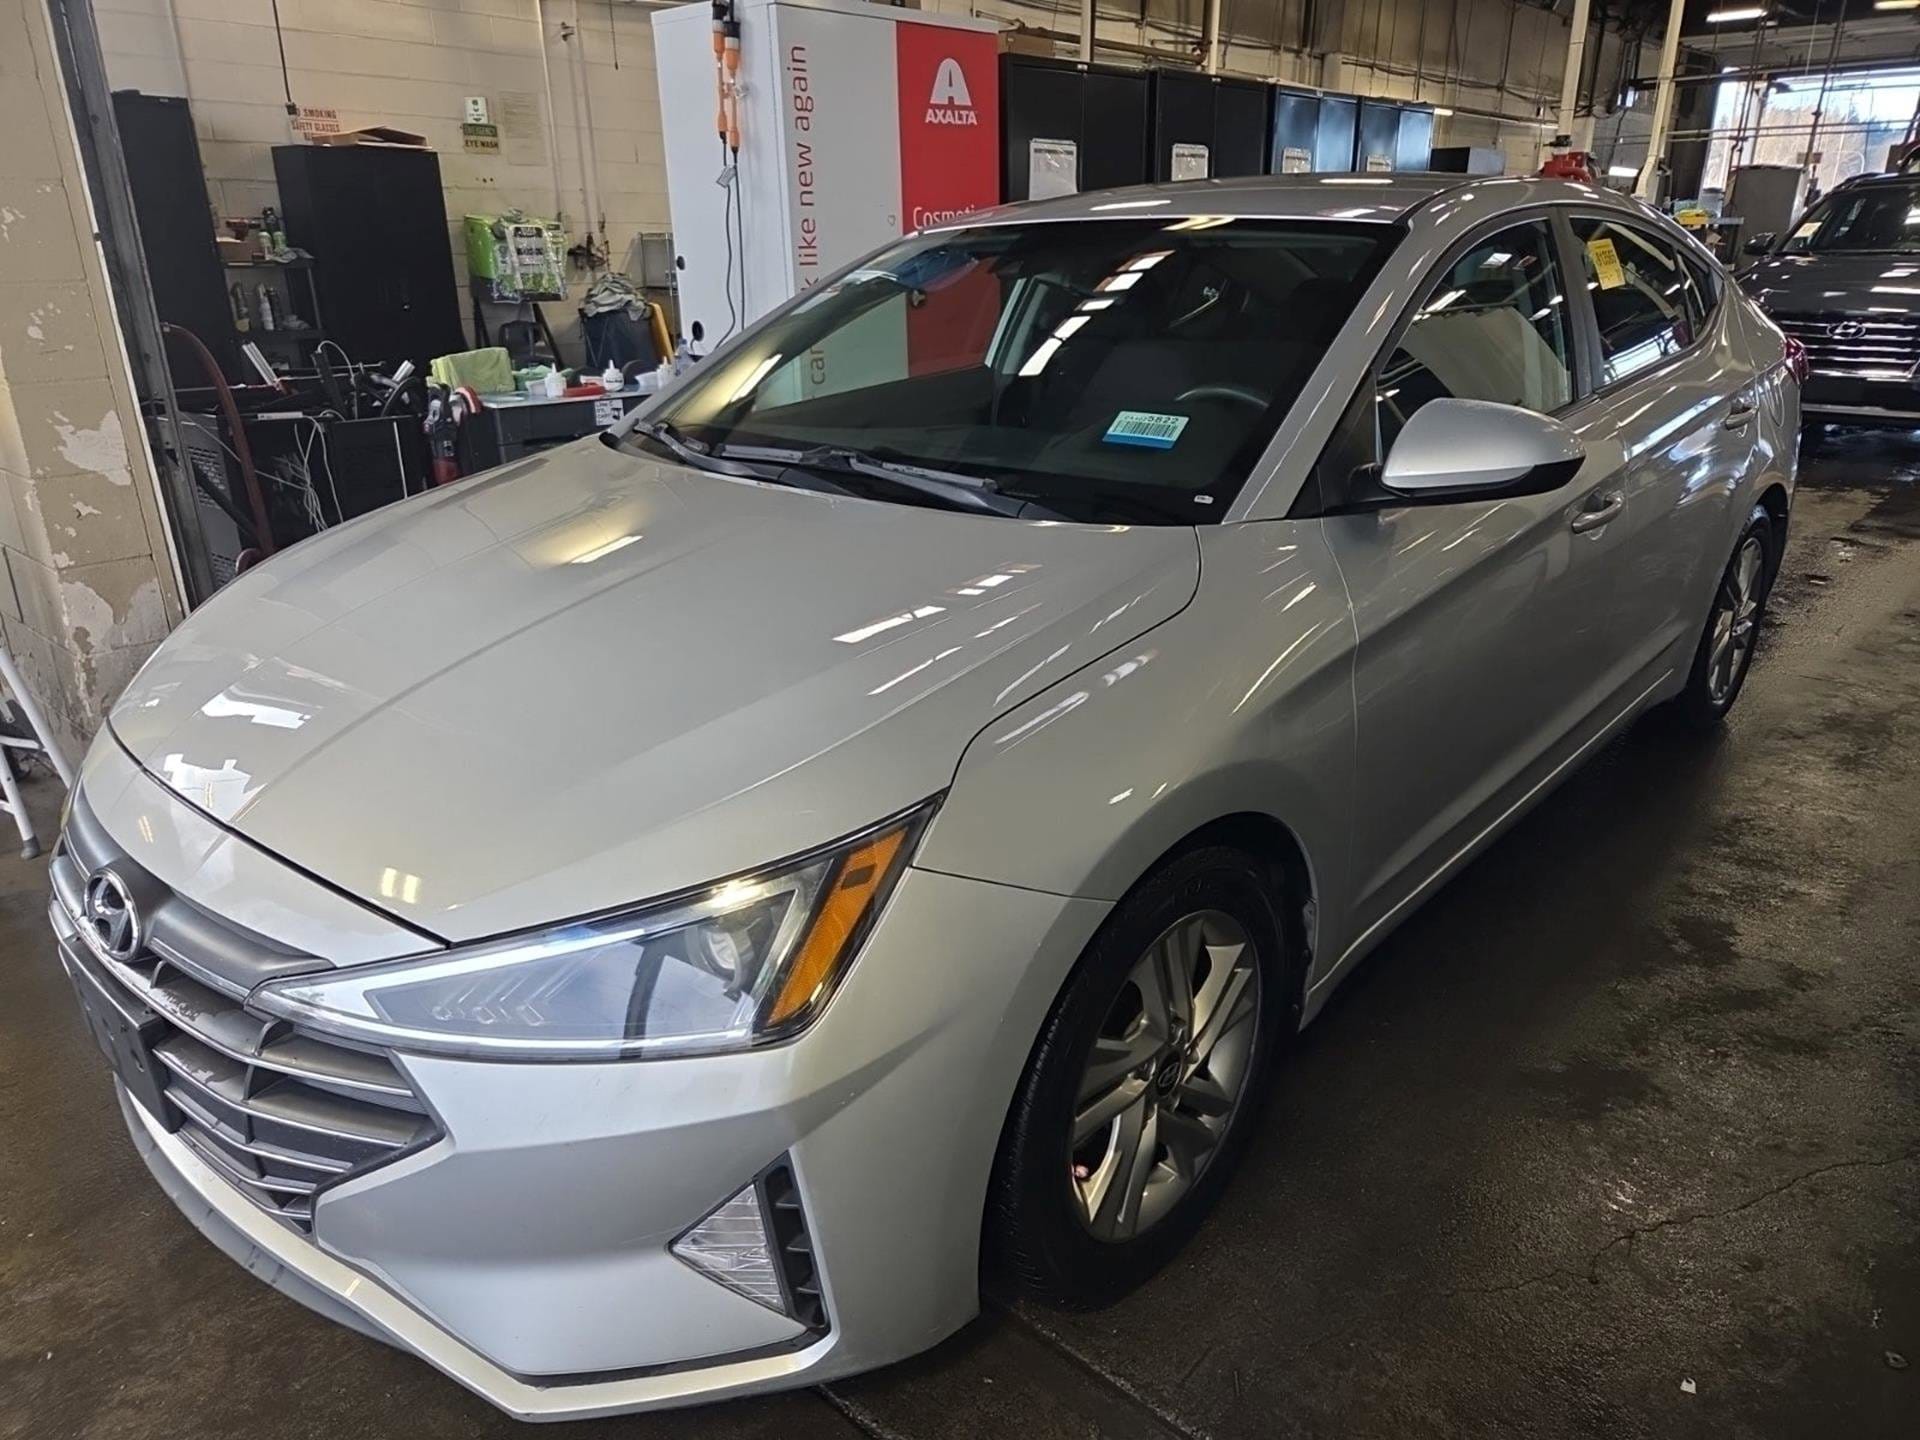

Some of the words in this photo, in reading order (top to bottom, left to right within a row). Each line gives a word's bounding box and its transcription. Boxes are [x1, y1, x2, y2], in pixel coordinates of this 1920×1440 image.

[787, 46, 814, 132] again
[303, 109, 336, 119] SMOKING
[925, 109, 977, 125] AXALTA
[291, 120, 313, 131] SAFETY
[314, 122, 340, 133] GLASSES
[464, 140, 479, 148] EYE
[480, 140, 499, 149] WASH
[797, 143, 814, 206] new
[798, 218, 818, 266] like
